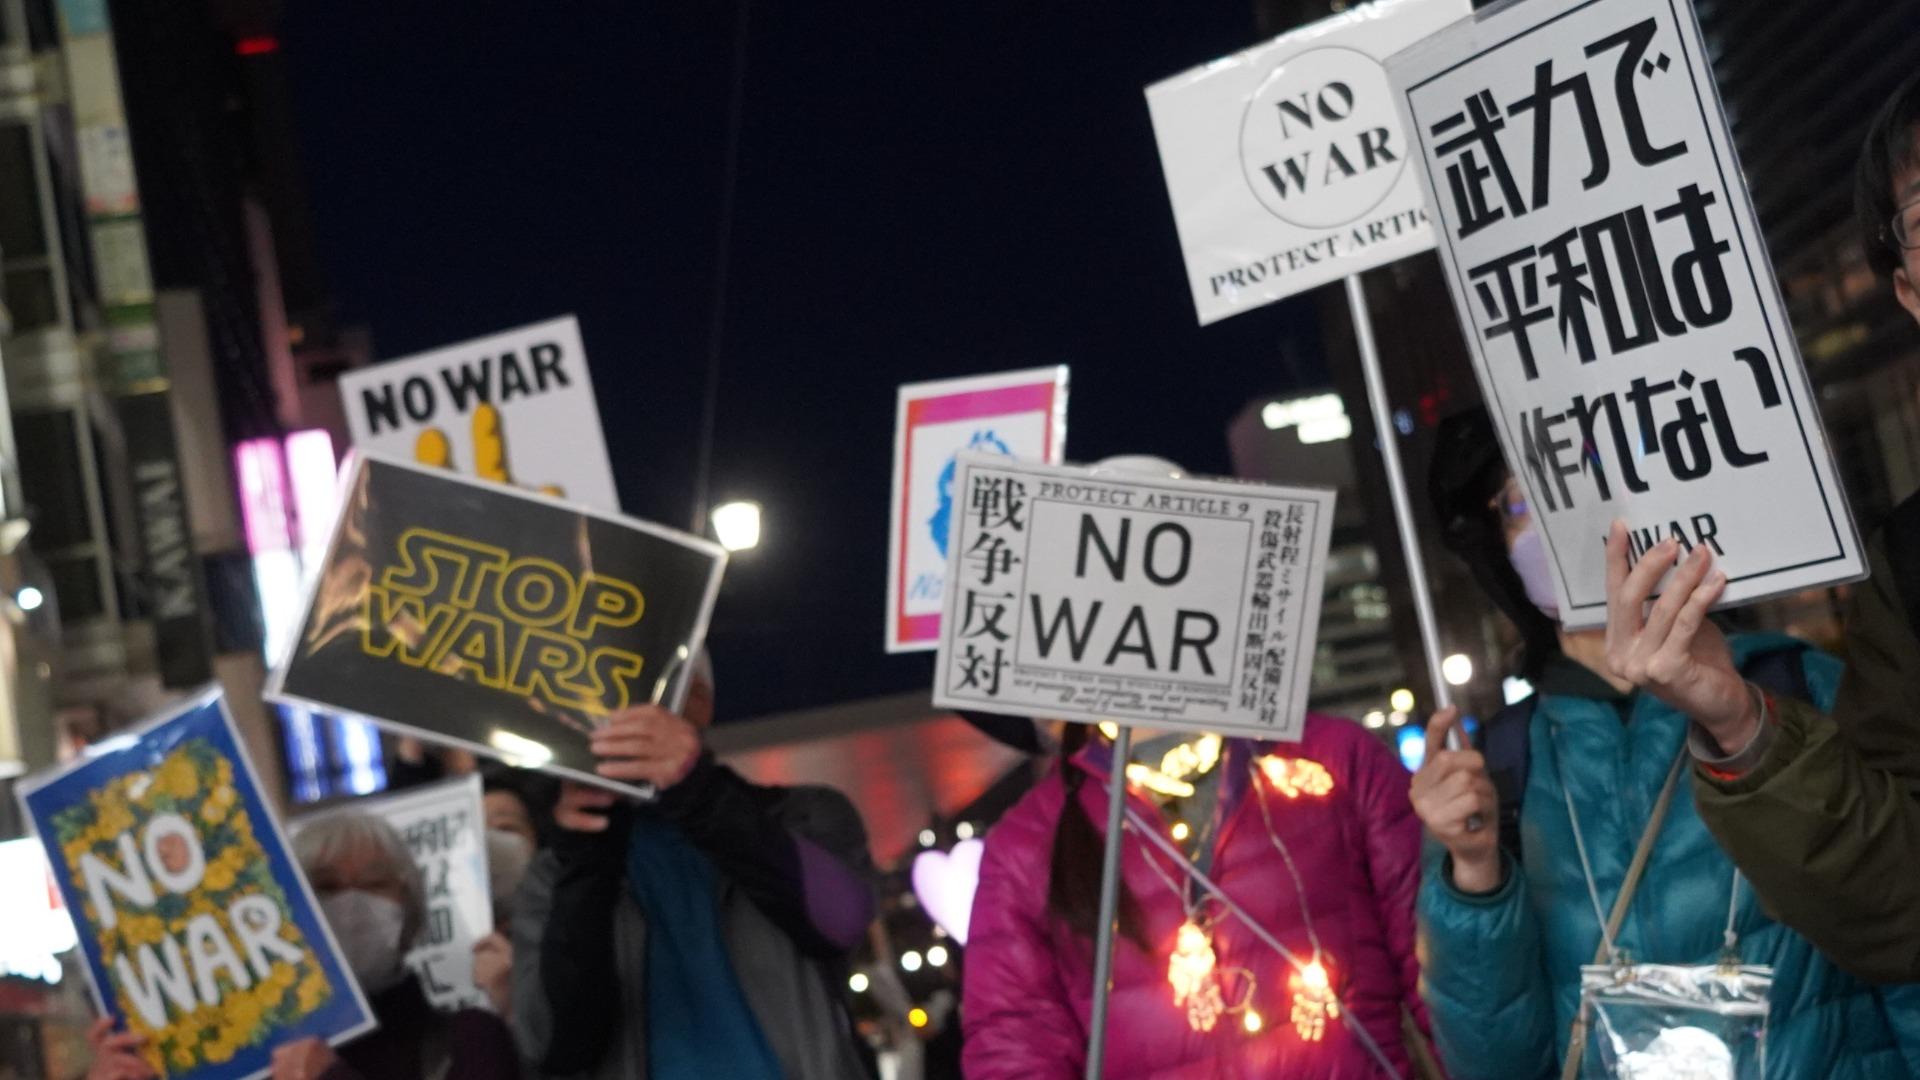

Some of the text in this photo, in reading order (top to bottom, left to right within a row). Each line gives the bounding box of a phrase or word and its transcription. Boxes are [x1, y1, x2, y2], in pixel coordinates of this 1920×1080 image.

[1261, 126, 1399, 201] WAR
[1275, 81, 1355, 140] NO
[1430, 17, 1689, 240] 武力で
[1209, 234, 1341, 297] PROTECT
[1468, 182, 1734, 382] 平和は
[361, 342, 571, 437] NO WAR
[1520, 346, 1782, 513] 作れない
[1040, 482, 1250, 518] PROTECT ARTICLE 9
[1075, 513, 1192, 587] NO
[384, 527, 645, 639] STOP
[953, 475, 1027, 698] 戦争反対
[1030, 593, 1220, 677] WAR
[361, 583, 645, 717] WARS
[78, 814, 206, 930] NO
[115, 894, 304, 1029] WAR
